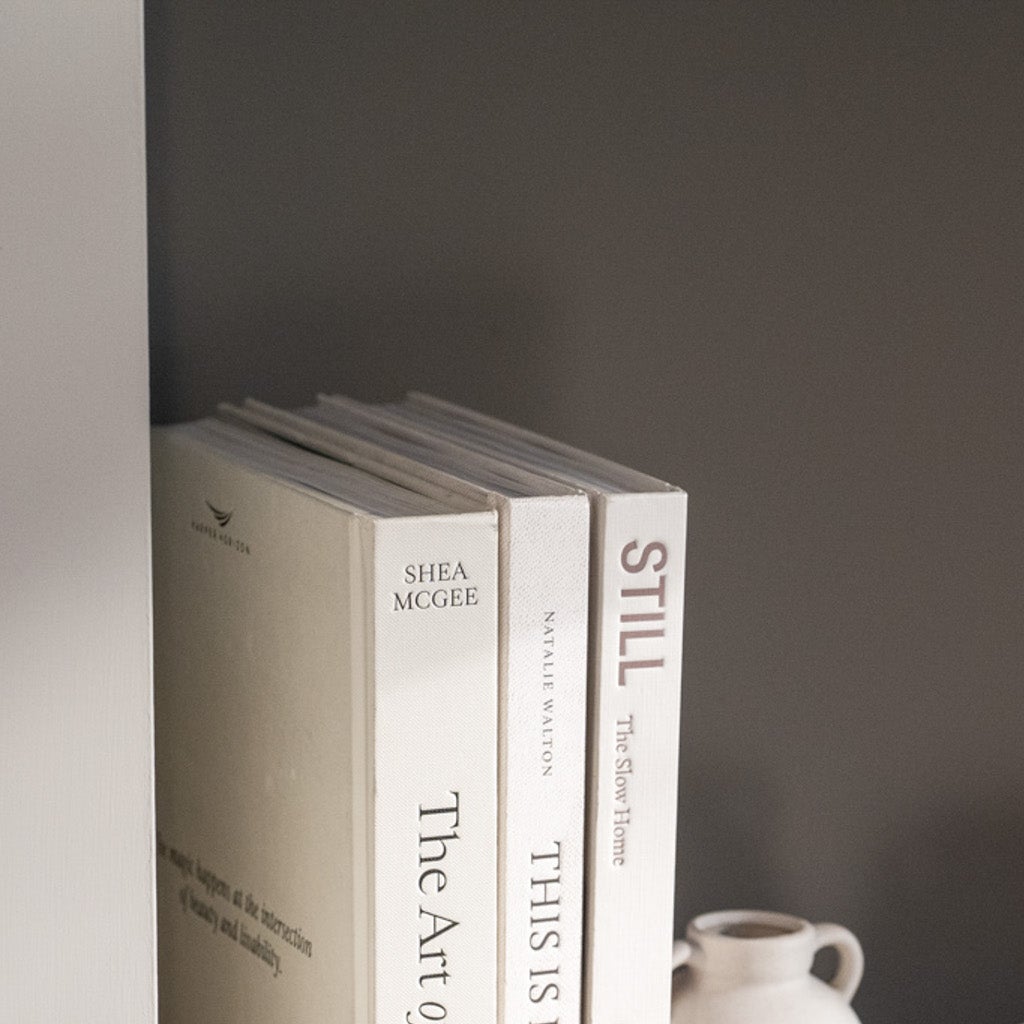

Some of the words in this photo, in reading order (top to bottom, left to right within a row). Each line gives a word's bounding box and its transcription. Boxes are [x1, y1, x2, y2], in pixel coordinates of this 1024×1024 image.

[393, 587, 479, 611] MCGEE
[404, 561, 469, 584] SHEA
[617, 537, 669, 687] STILL
[543, 610, 556, 691] NATALIE
[542, 698, 553, 777] WALTON
[615, 714, 634, 754] The
[614, 757, 633, 803] Slow
[418, 790, 461, 895] The
[612, 807, 631, 867] Home
[528, 840, 562, 951] THIS
[261, 903, 313, 958] intersection
[418, 904, 460, 988] Art
[528, 966, 560, 1004] IS
